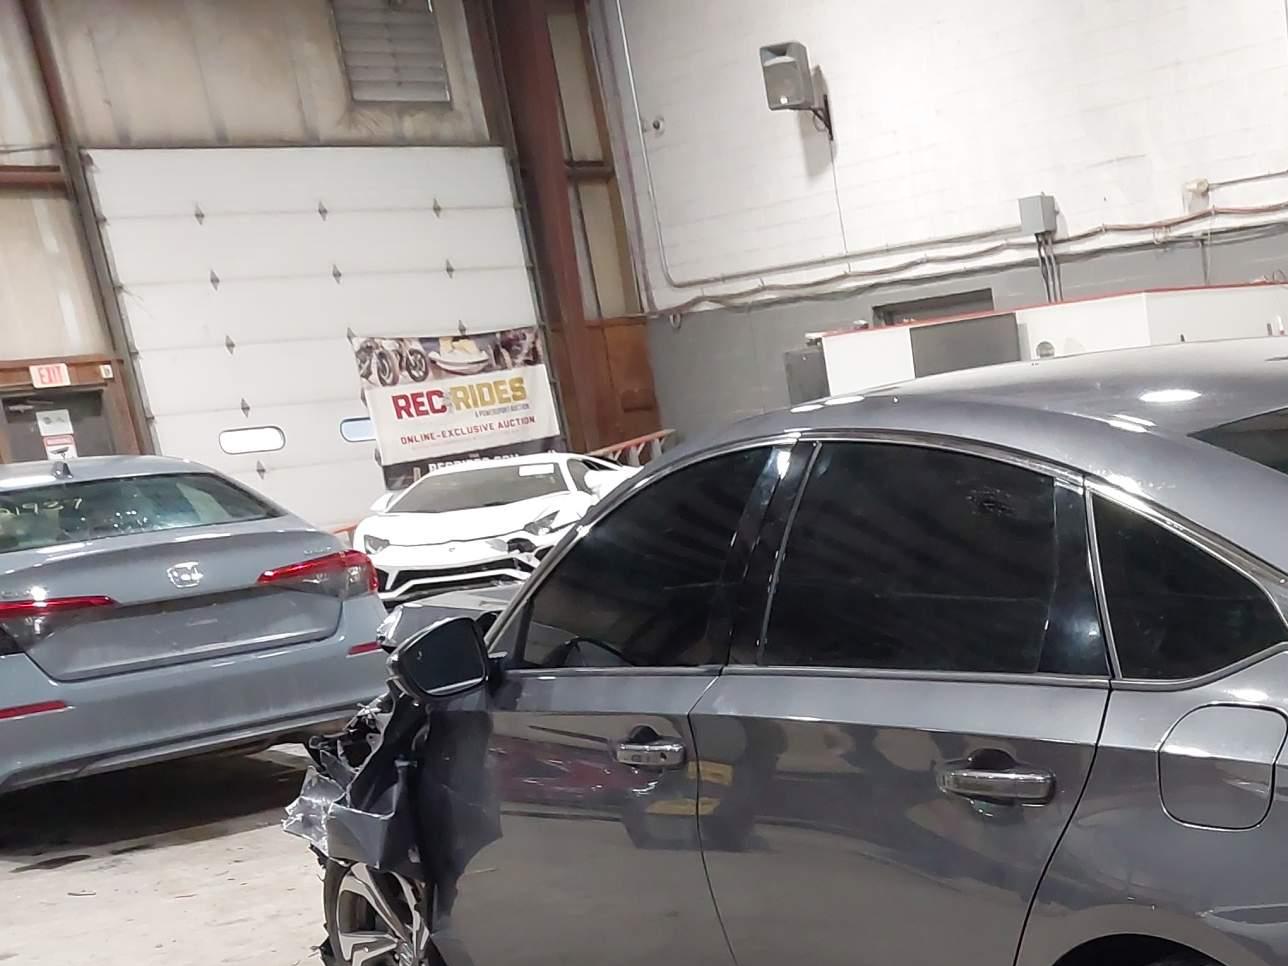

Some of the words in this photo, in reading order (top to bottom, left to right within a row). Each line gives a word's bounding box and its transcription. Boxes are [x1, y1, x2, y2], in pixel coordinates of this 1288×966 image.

[38, 366, 64, 385] EXIT
[391, 389, 448, 420] REC
[450, 377, 528, 411] RIDES
[400, 422, 495, 446] ONLINE-EXCLUSIVE
[497, 415, 536, 430] AUCTION
